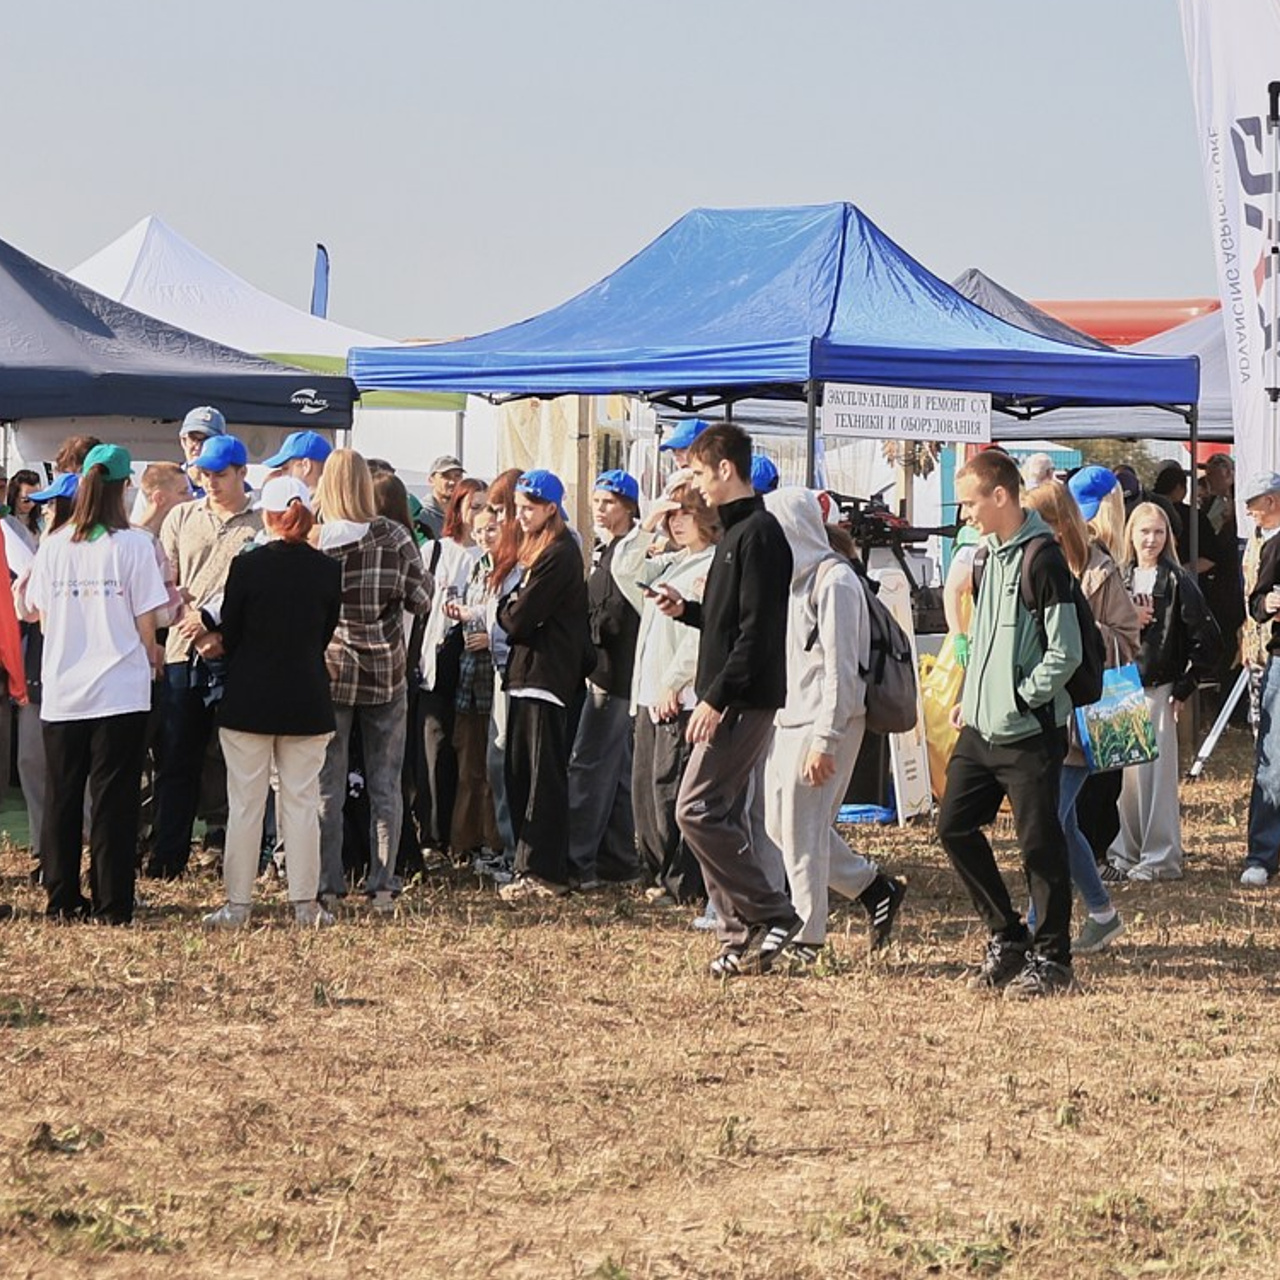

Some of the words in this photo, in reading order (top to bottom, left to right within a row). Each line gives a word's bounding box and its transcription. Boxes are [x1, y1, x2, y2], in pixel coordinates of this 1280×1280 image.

[827, 389, 909, 410] ЭКСПЛУАТАЦИЯ
[913, 395, 921, 410] И
[925, 395, 967, 413] РЕМОНТ
[834, 413, 883, 430] ТЕХНИКИ
[888, 415, 896, 431] И
[900, 416, 981, 435] ОБОРУДОВАНИЯ
